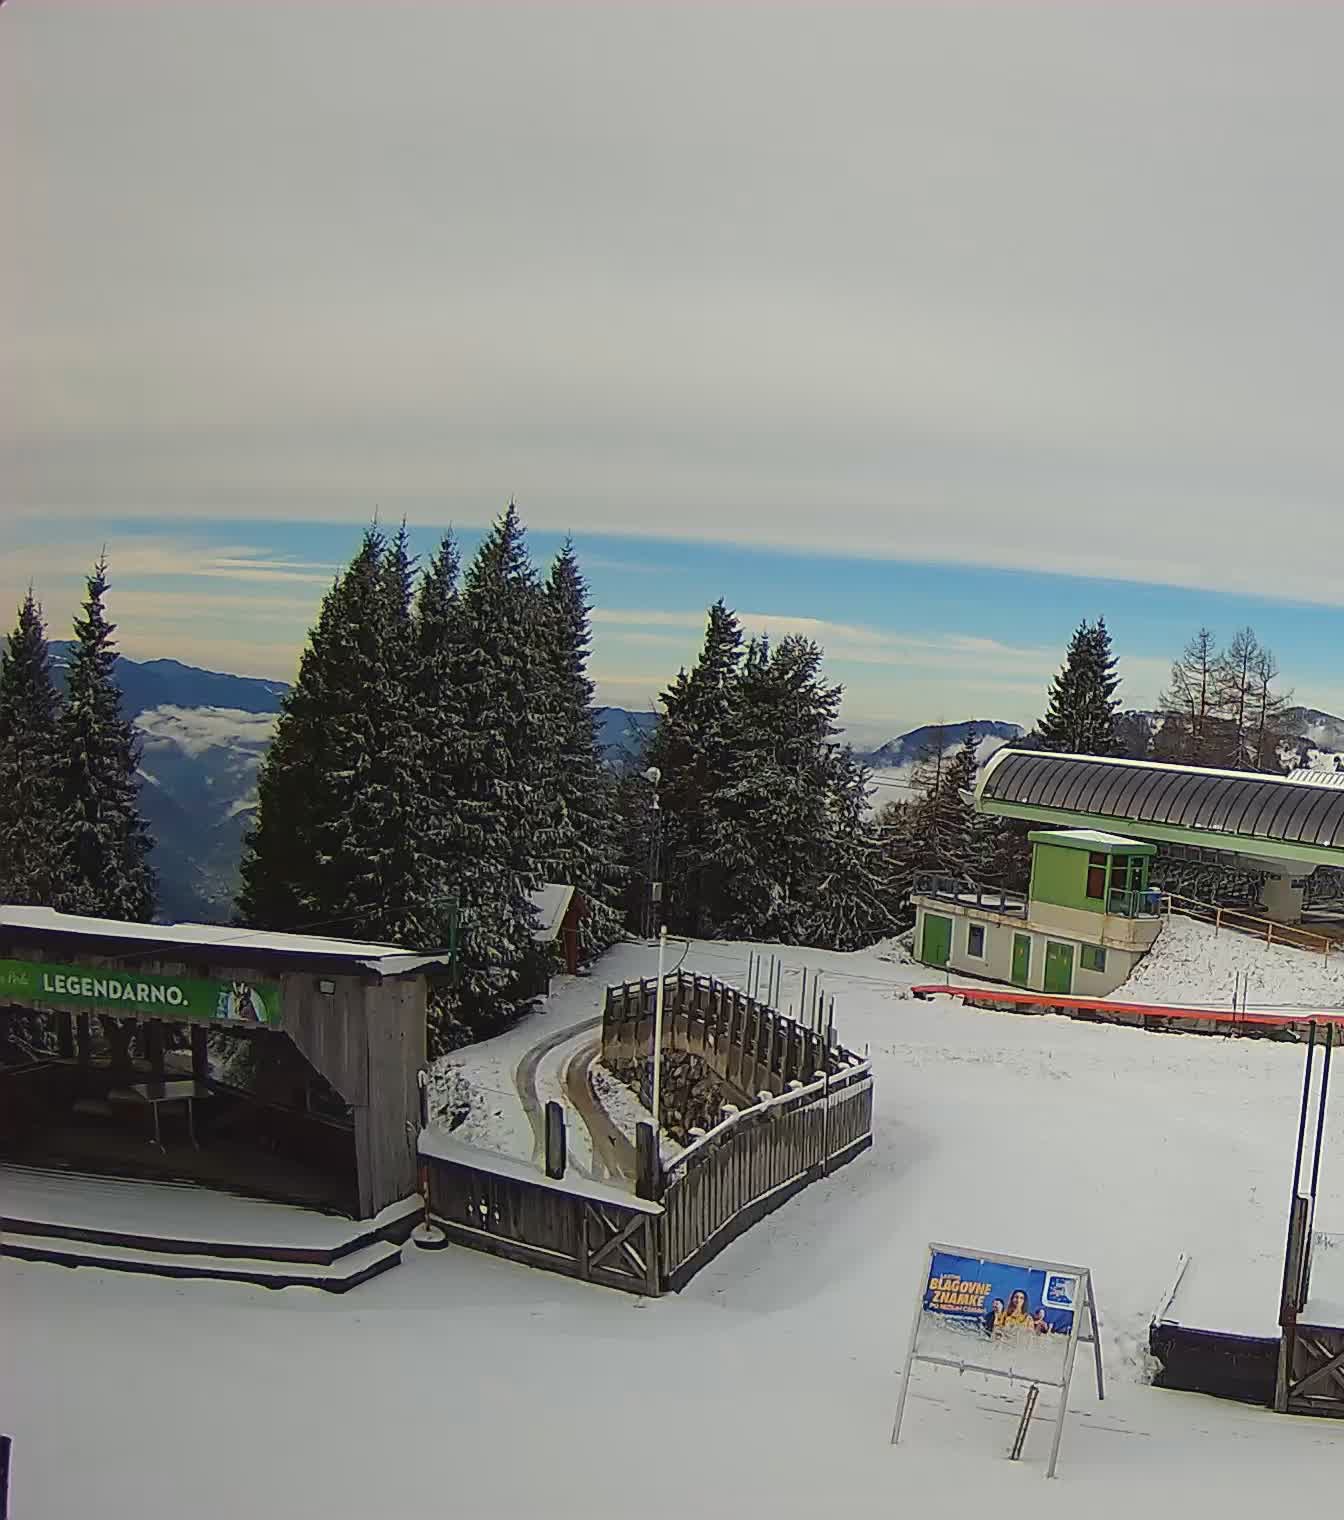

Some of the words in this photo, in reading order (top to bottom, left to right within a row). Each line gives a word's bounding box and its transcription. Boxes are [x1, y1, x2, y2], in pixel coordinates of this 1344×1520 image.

[42, 972, 190, 1007] LEGENDARNO.
[929, 1277, 993, 1296] BLAGOVNE
[932, 1290, 986, 1308] ZNAMKE
